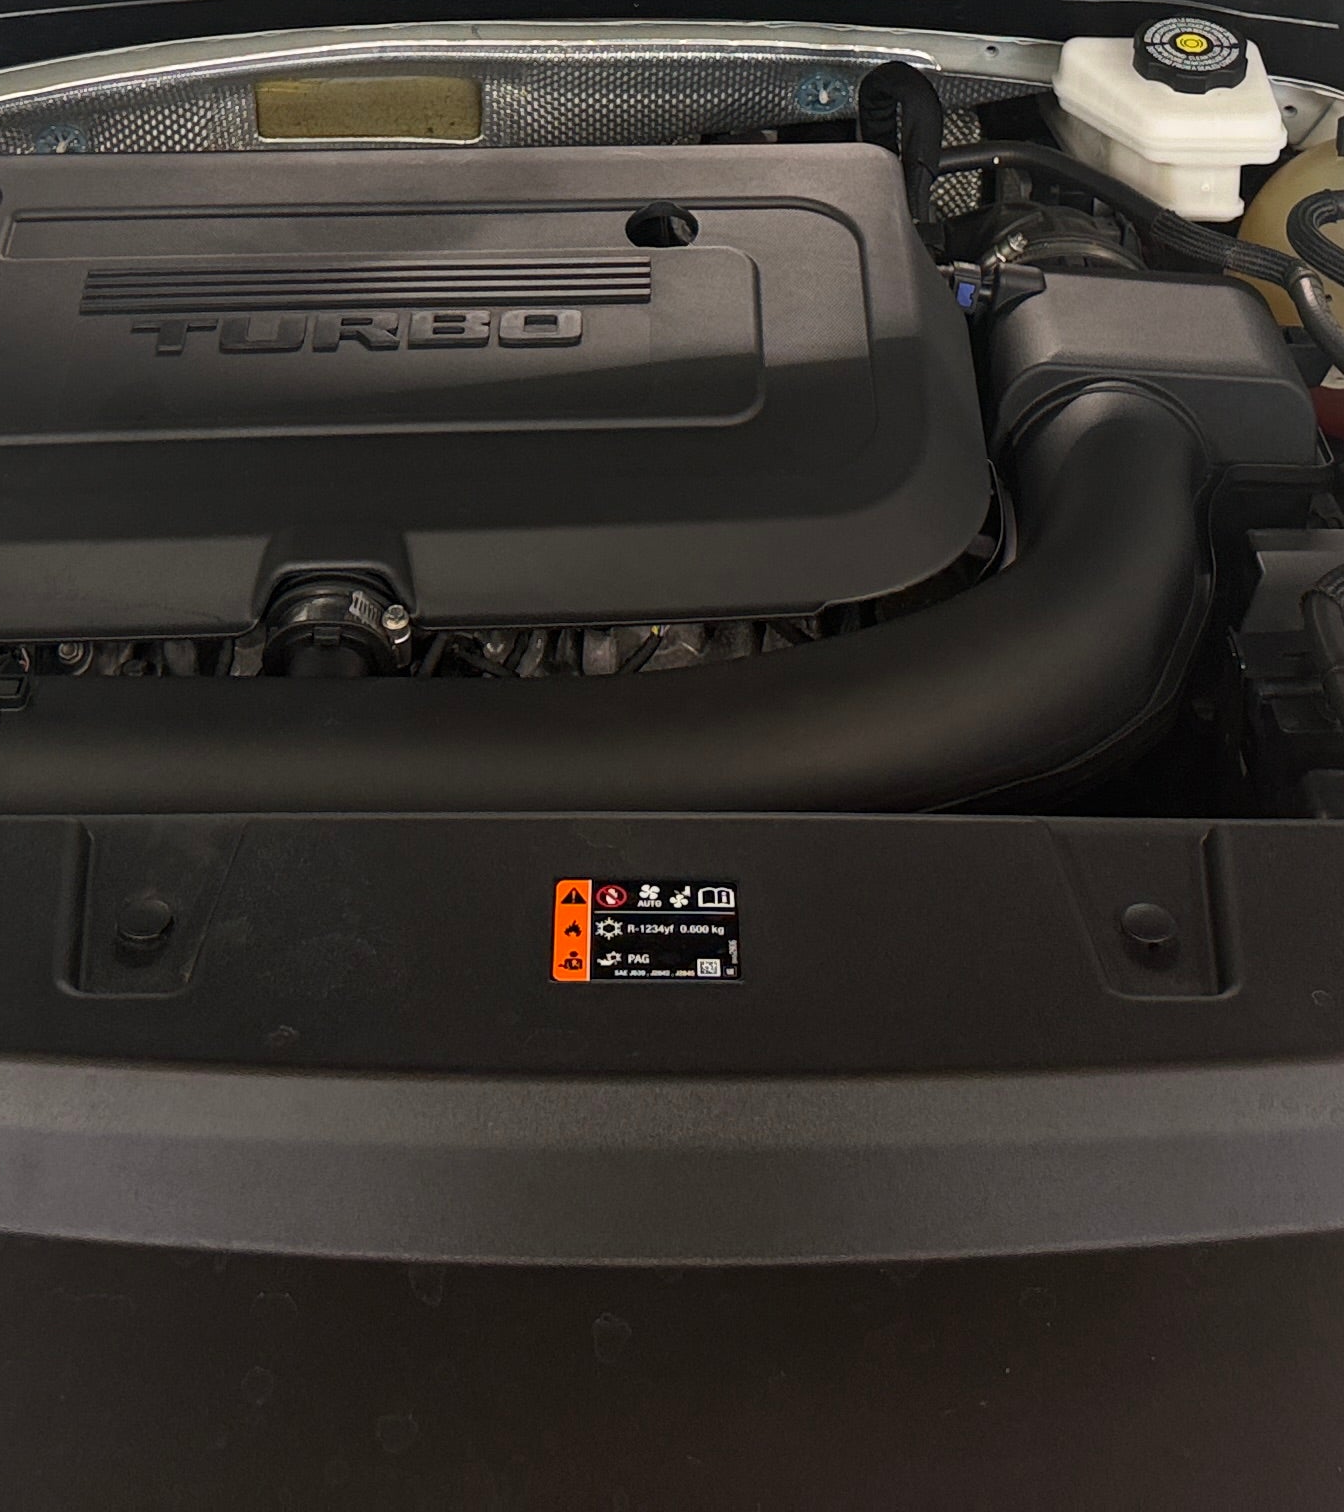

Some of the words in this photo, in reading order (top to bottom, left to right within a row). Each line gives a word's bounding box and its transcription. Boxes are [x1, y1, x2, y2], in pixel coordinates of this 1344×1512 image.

[131, 309, 584, 356] TURBO
[637, 899, 662, 908] AUTO
[627, 924, 675, 935] R-1234yf
[679, 924, 710, 934] 0.600
[711, 924, 725, 936] kg
[627, 954, 650, 964] PAG
